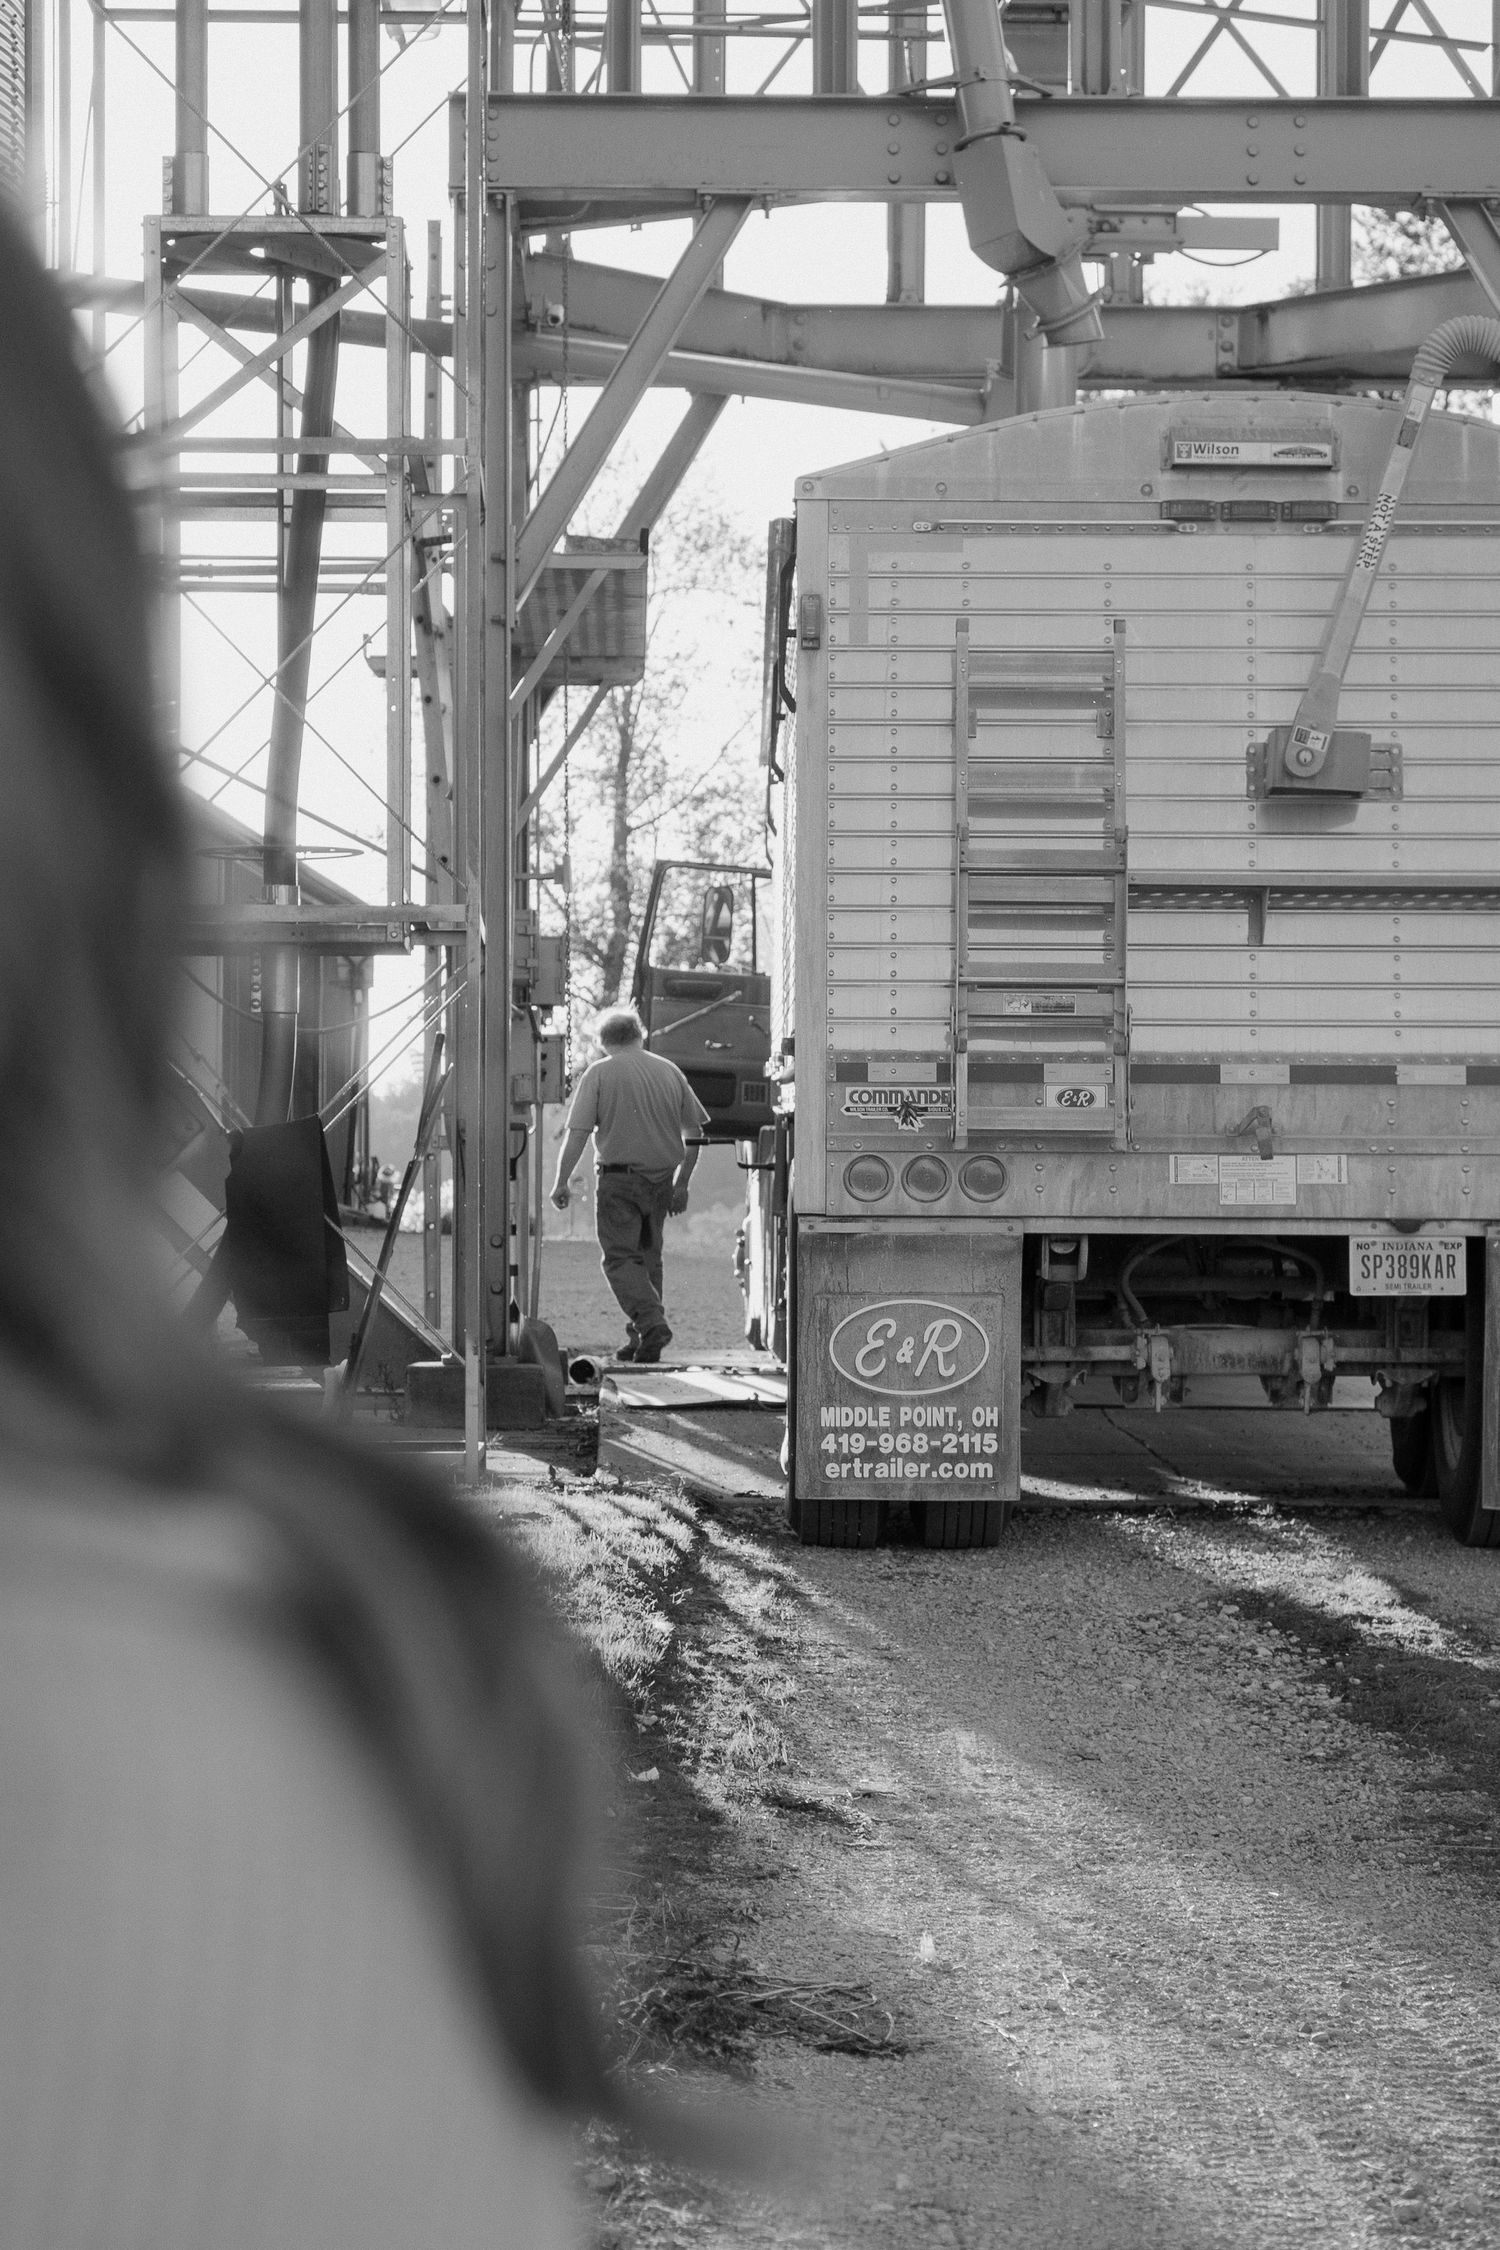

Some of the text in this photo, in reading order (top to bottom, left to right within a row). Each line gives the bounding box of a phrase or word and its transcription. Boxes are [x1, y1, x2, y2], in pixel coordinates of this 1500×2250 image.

[1193, 443, 1239, 455] Wilson
[1363, 494, 1392, 569] NOT A STEP
[849, 1089, 952, 1105] COMMANDE
[1356, 1242, 1463, 1251] NO INDIANA EXP
[1361, 1254, 1456, 1279] SP389KAR
[820, 1406, 998, 1432] MIDDLE POINT, OH
[820, 1432, 998, 1454] 419-968-2115
[825, 1457, 994, 1479] ertrailer.com
